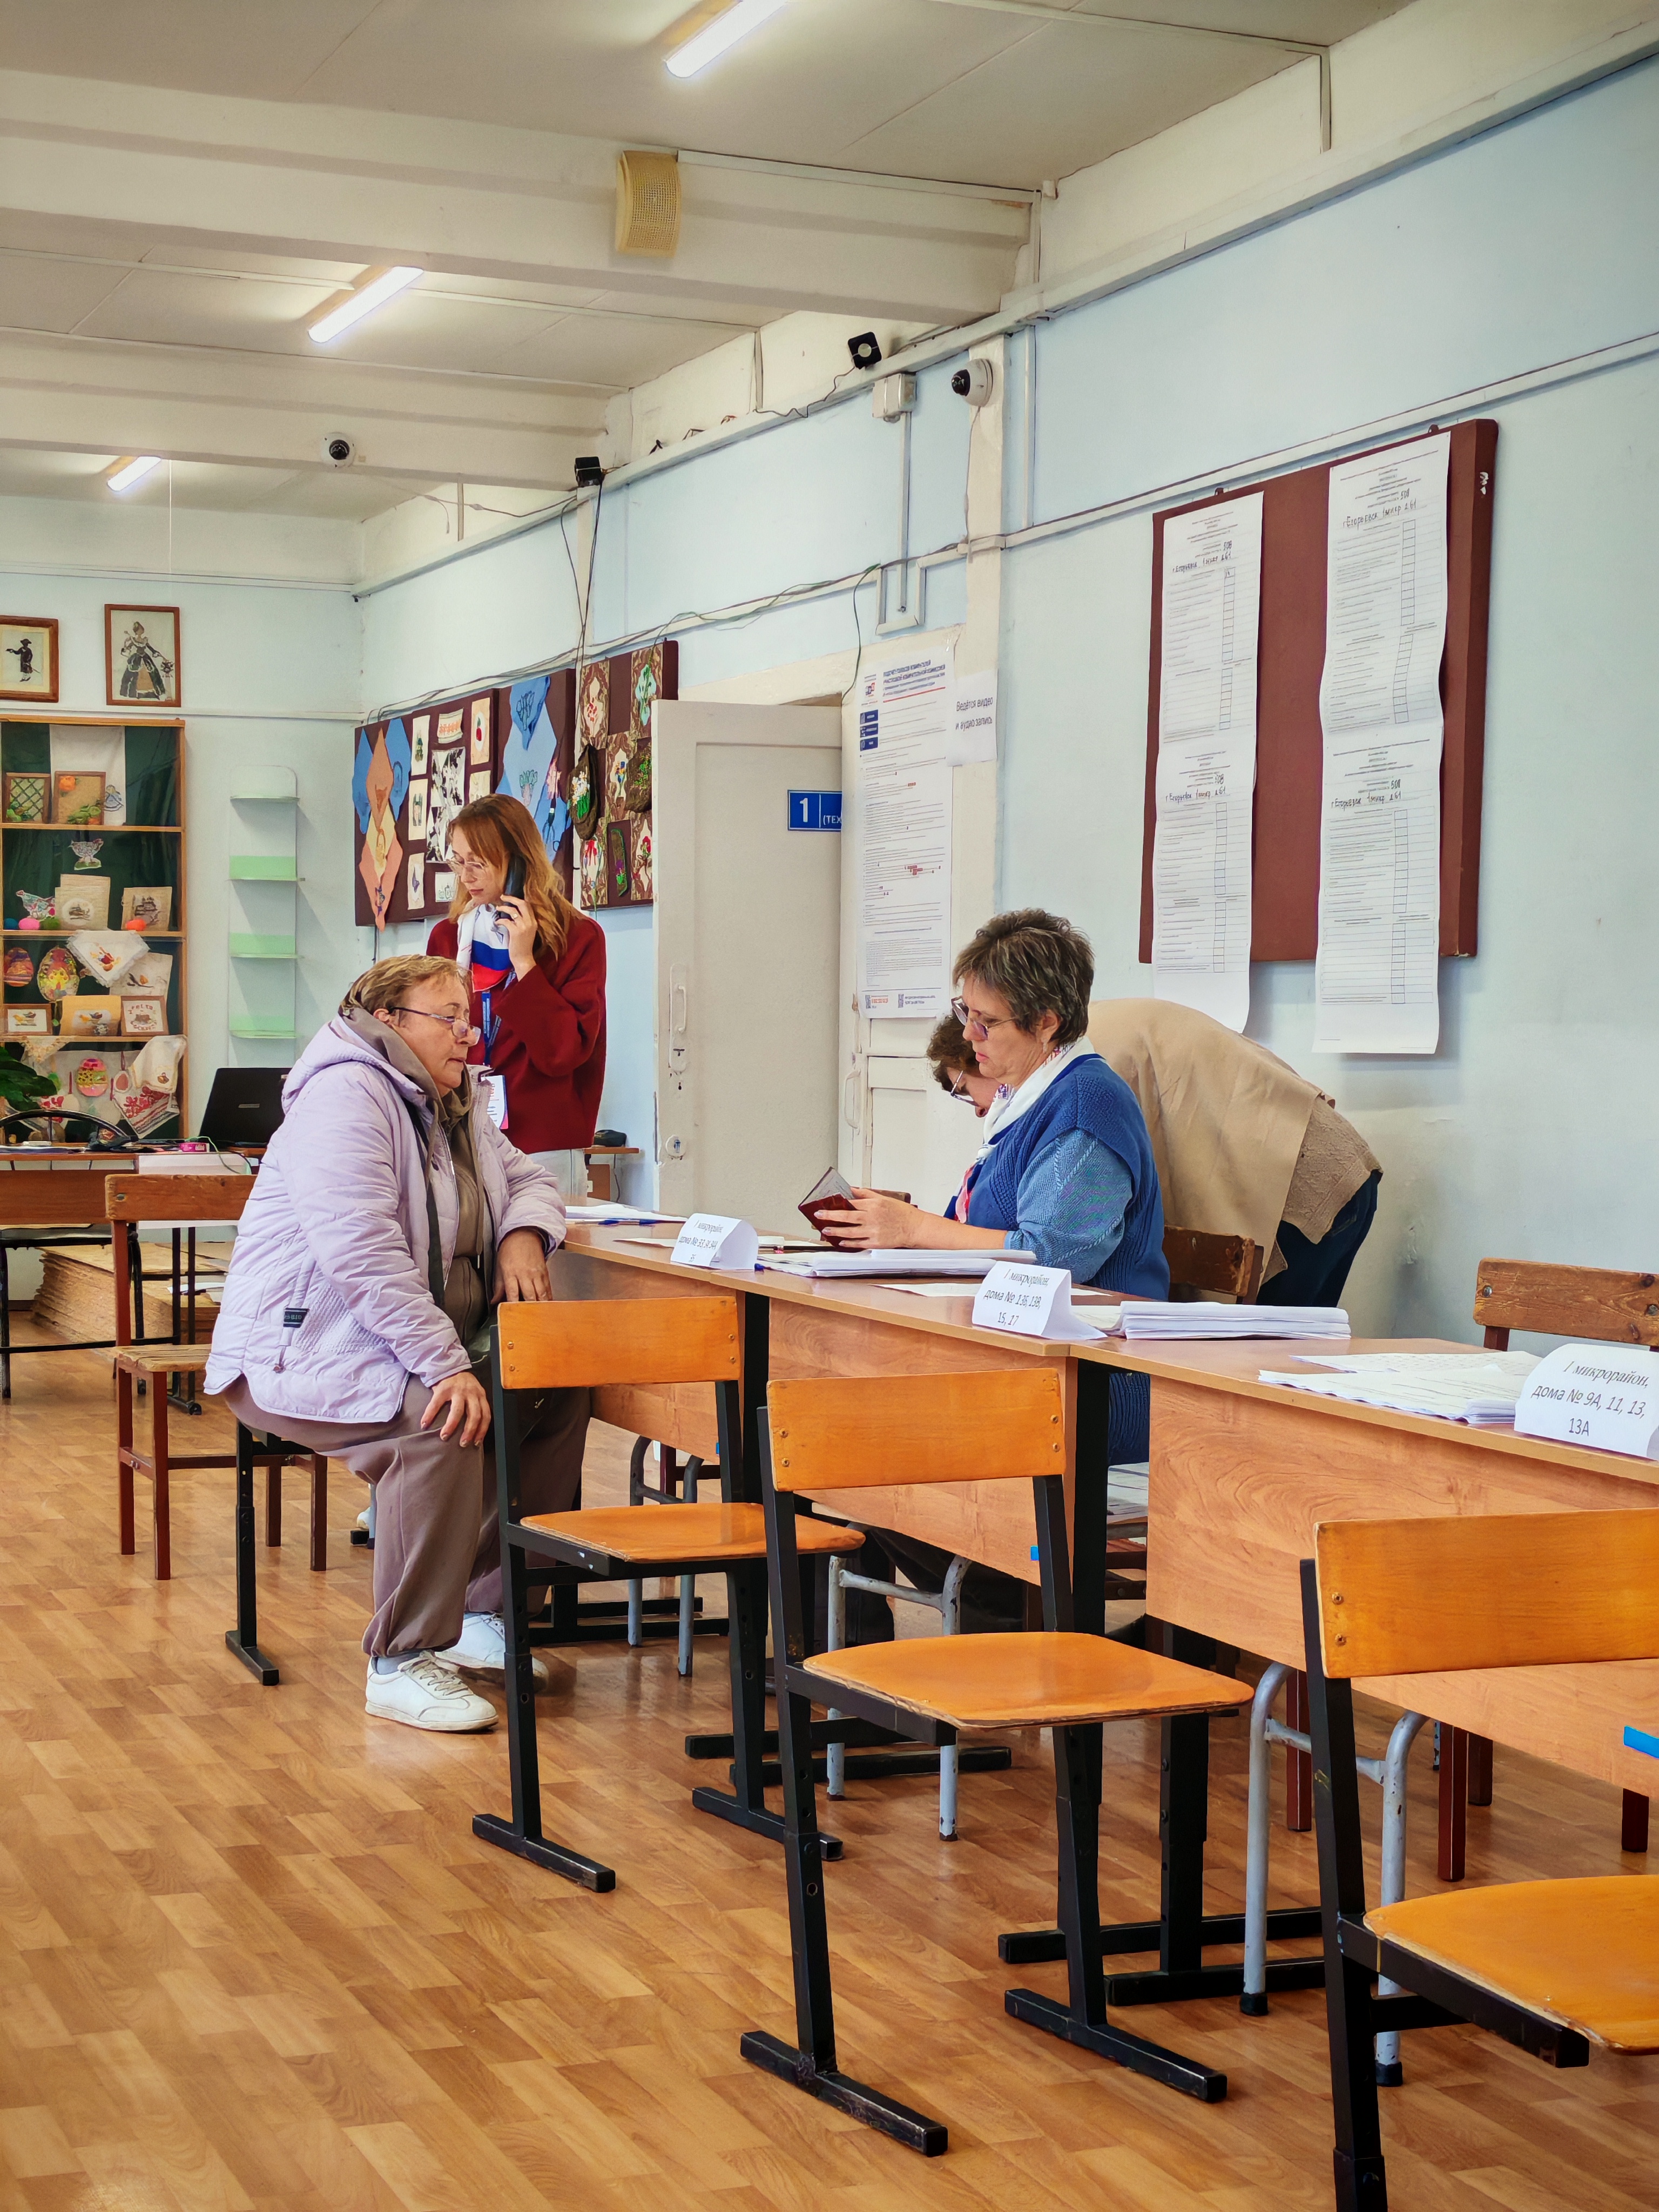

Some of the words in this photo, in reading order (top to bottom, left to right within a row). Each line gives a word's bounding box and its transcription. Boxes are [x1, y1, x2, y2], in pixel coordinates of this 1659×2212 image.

[799, 798, 808, 822] 1
[983, 1290, 1004, 1300] дома
[1004, 1291, 1015, 1303] №
[997, 1312, 1007, 1326] 15,
[1008, 1315, 1020, 1326] 17
[1572, 1365, 1650, 1388] микрорайон,
[1530, 1385, 1566, 1401] дома
[1566, 1388, 1583, 1404] №
[1583, 1392, 1602, 1411] 9А,
[1606, 1396, 1623, 1415] 11,
[1627, 1400, 1646, 1419] 13,
[1569, 1418, 1590, 1437] 13А
